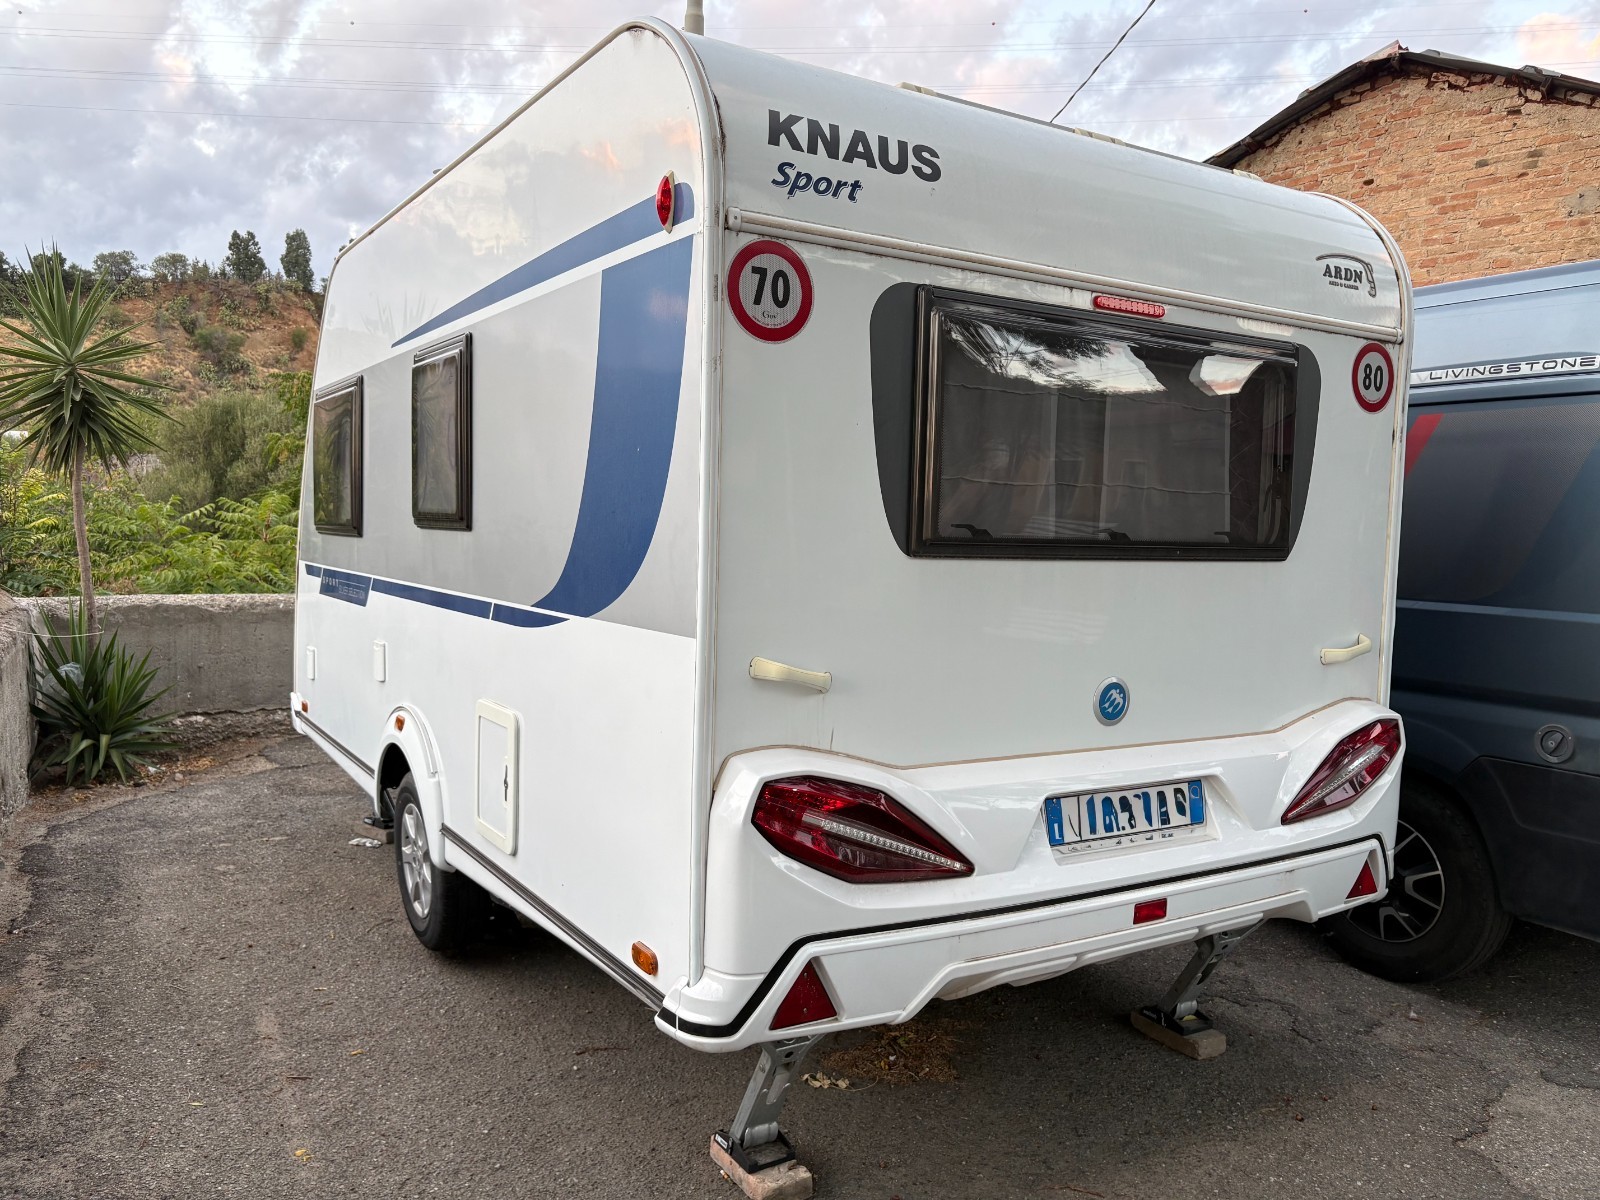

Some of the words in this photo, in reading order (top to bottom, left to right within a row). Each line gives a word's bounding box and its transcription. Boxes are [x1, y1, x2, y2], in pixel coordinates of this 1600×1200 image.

[768, 109, 941, 182] KNAUS
[771, 162, 863, 203] Sport
[751, 265, 790, 308] 70
[1323, 264, 1363, 284] ARDN
[1363, 363, 1383, 392] 80
[1429, 356, 1597, 380] LIVINGSTONE
